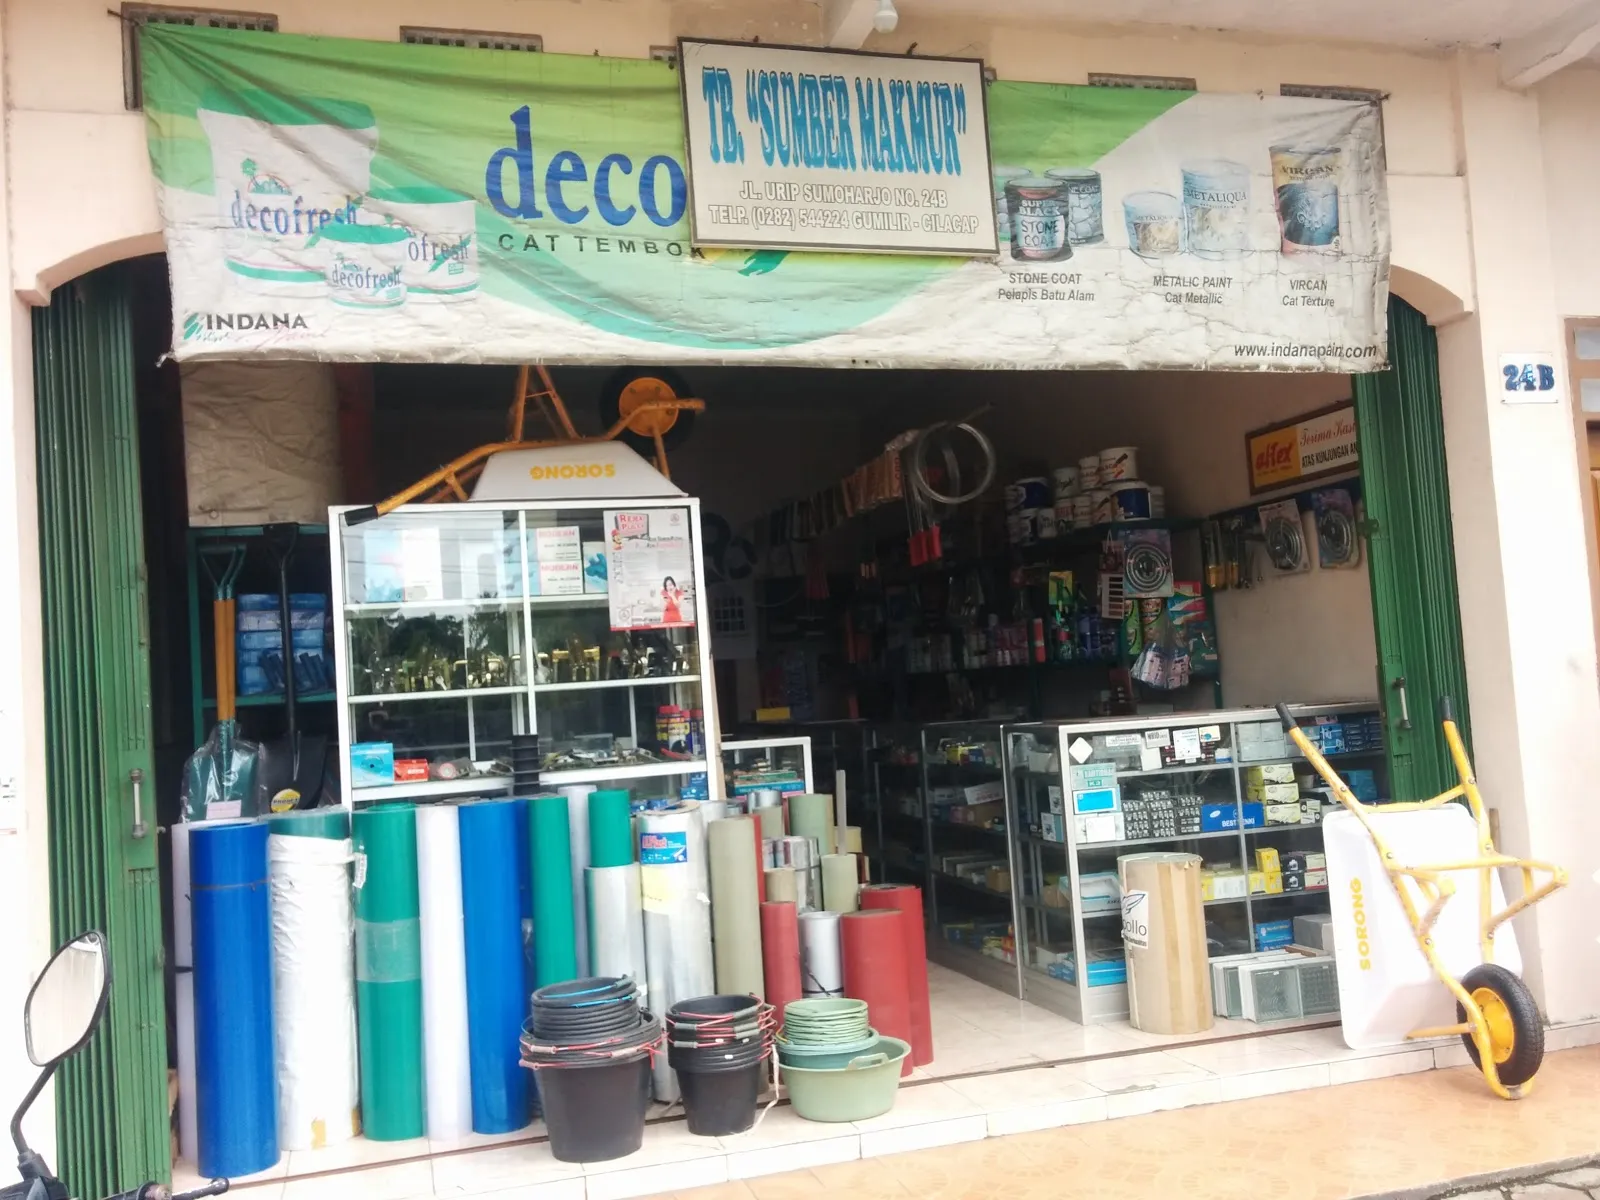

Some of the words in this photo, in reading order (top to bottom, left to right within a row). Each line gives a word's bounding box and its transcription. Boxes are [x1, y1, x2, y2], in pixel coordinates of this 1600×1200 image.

[702, 66, 744, 164] TB.
[485, 105, 687, 227] deco
[740, 180, 762, 200] JL.
[764, 181, 800, 201] URIP
[803, 183, 892, 206] SUMOHARJO
[894, 188, 920, 207] NO.
[921, 189, 948, 208] 24B
[708, 204, 749, 225] TELP.
[751, 206, 796, 231] (0282)
[799, 208, 849, 229] 544224
[852, 211, 912, 231] GUMILIR
[921, 213, 979, 233] CILACAP
[1021, 220, 1059, 233] STONE
[407, 233, 469, 262] ofresh
[498, 233, 559, 252] CAT
[573, 235, 705, 259] TEMBOK
[1009, 272, 1048, 284] STONE
[1051, 274, 1082, 284] COAT
[1153, 276, 1200, 288] METALIC
[1202, 277, 1233, 288] PAINT
[1290, 280, 1328, 290] VIRCAN
[998, 288, 1037, 302] Pelapis
[1041, 289, 1065, 300] Batu
[1068, 290, 1095, 301] Alam
[1164, 292, 1182, 303] Cat
[1184, 292, 1223, 304] Metallic
[1282, 295, 1298, 306] Cat
[1301, 296, 1335, 307] Texture
[206, 313, 308, 330] INDANA
[1503, 364, 1554, 391] 24B
[1302, 453, 1315, 468] ATAS
[1316, 445, 1348, 465] KUNJUNGAN
[530, 463, 616, 480] SORONG
[1221, 819, 1237, 828] BEST
[1240, 816, 1255, 826] ENKI
[1350, 877, 1371, 970] SORONG
